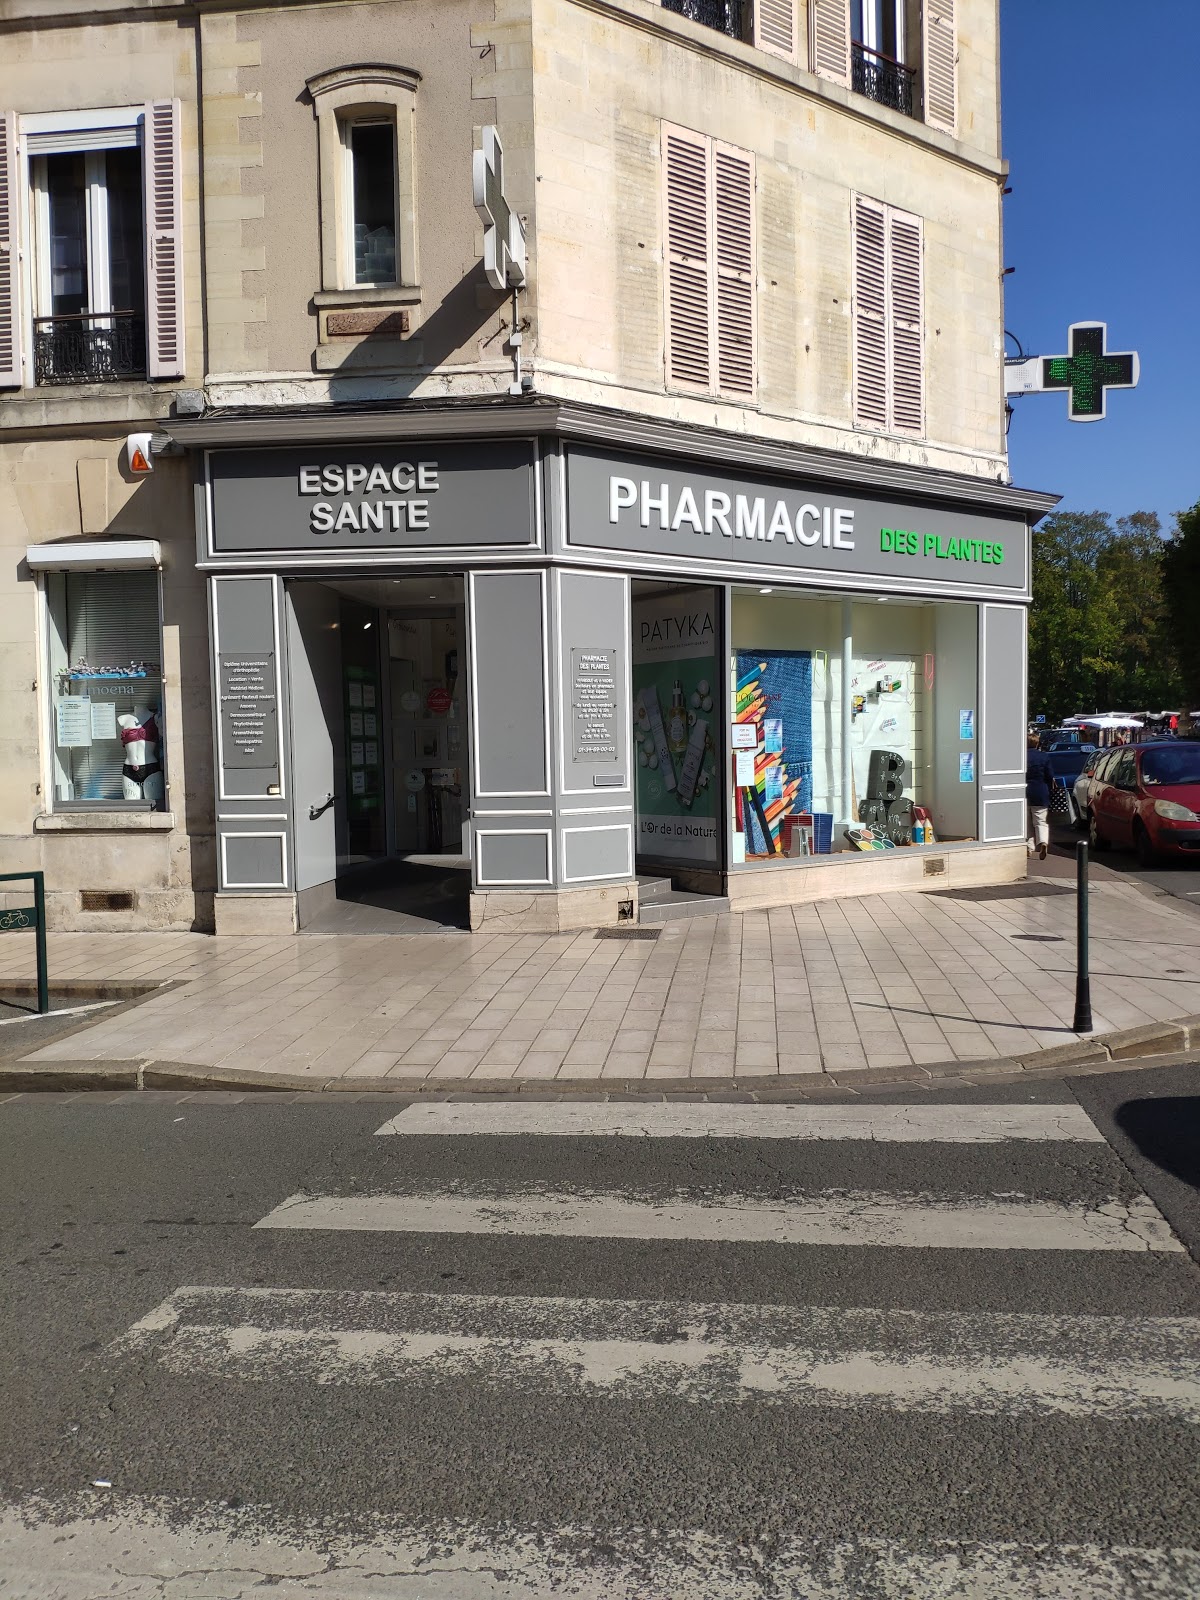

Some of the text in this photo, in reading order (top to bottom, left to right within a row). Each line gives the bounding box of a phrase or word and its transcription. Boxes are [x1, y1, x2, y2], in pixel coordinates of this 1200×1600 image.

[299, 461, 440, 495] ESPACE
[312, 500, 430, 531] SANTE
[609, 475, 1004, 564] PHARMACIE DES PLANTES
[641, 612, 714, 643] PATYKA
[82, 685, 135, 695] moena
[660, 822, 672, 834] de
[674, 823, 683, 836] la
